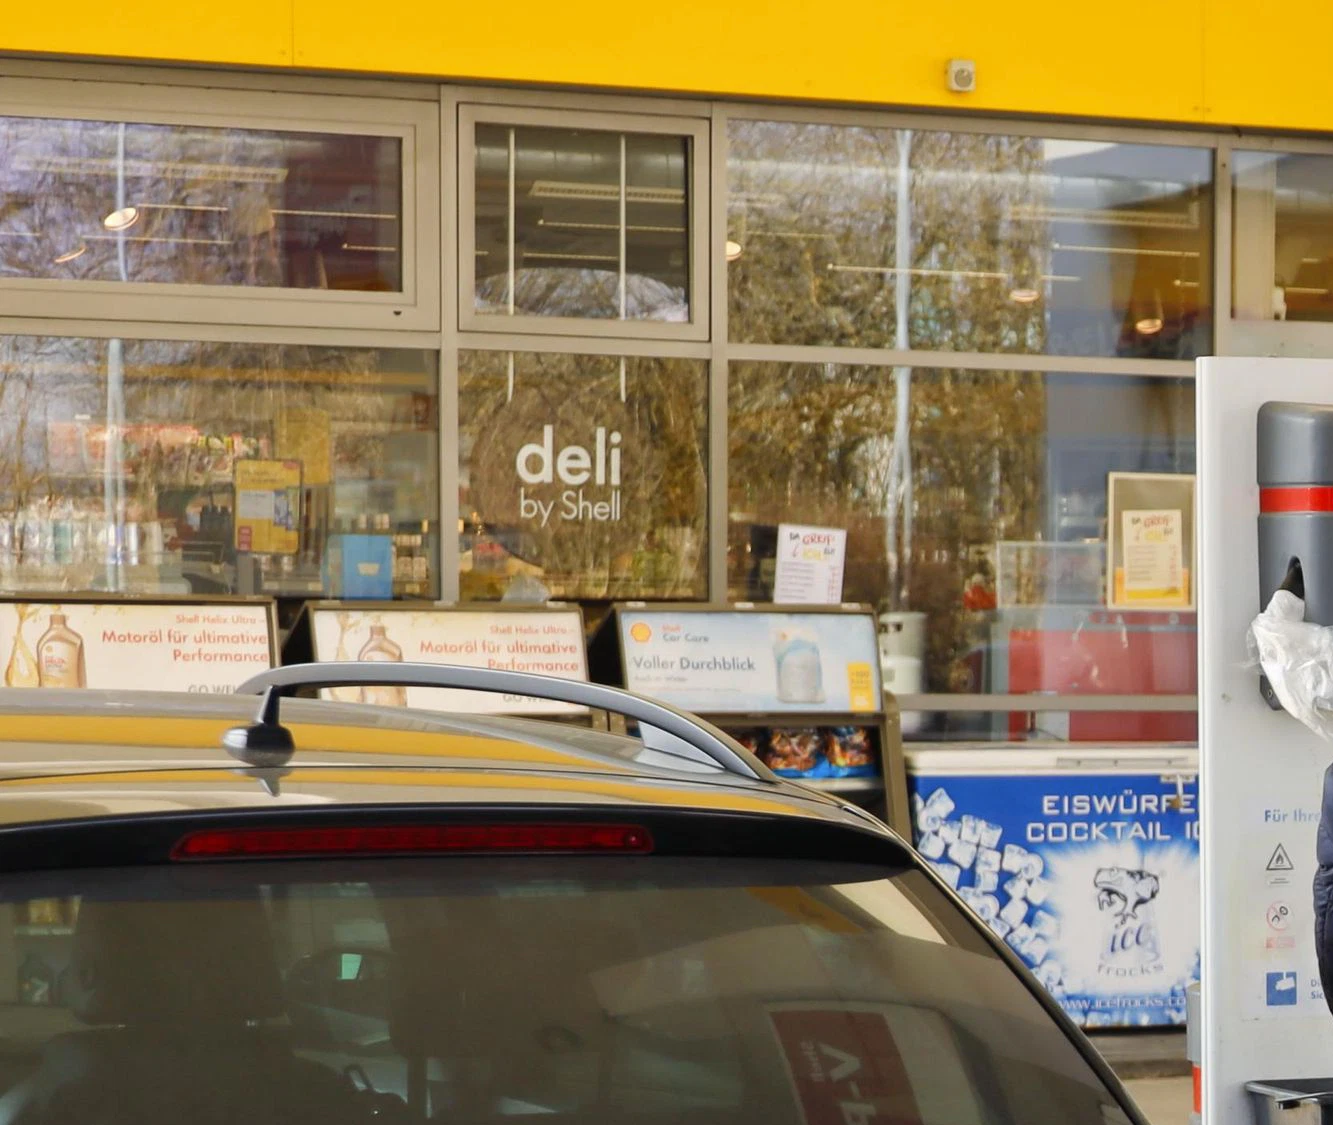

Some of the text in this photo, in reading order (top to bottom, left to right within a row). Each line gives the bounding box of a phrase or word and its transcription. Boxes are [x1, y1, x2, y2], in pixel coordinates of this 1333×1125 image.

[516, 424, 621, 486] deli
[520, 487, 621, 528] by Shell
[102, 629, 268, 645] Motoröl für ultimative
[663, 634, 709, 643] Car Care
[420, 640, 577, 655] Motoröl für ultimative
[173, 649, 268, 663] Performance
[633, 656, 756, 672] Voller Durchblick
[488, 659, 579, 672] Performance
[1043, 789, 1200, 815] EISWÜRFE
[1264, 809, 1288, 823] Für
[1027, 821, 1171, 843] COCKTAIL
